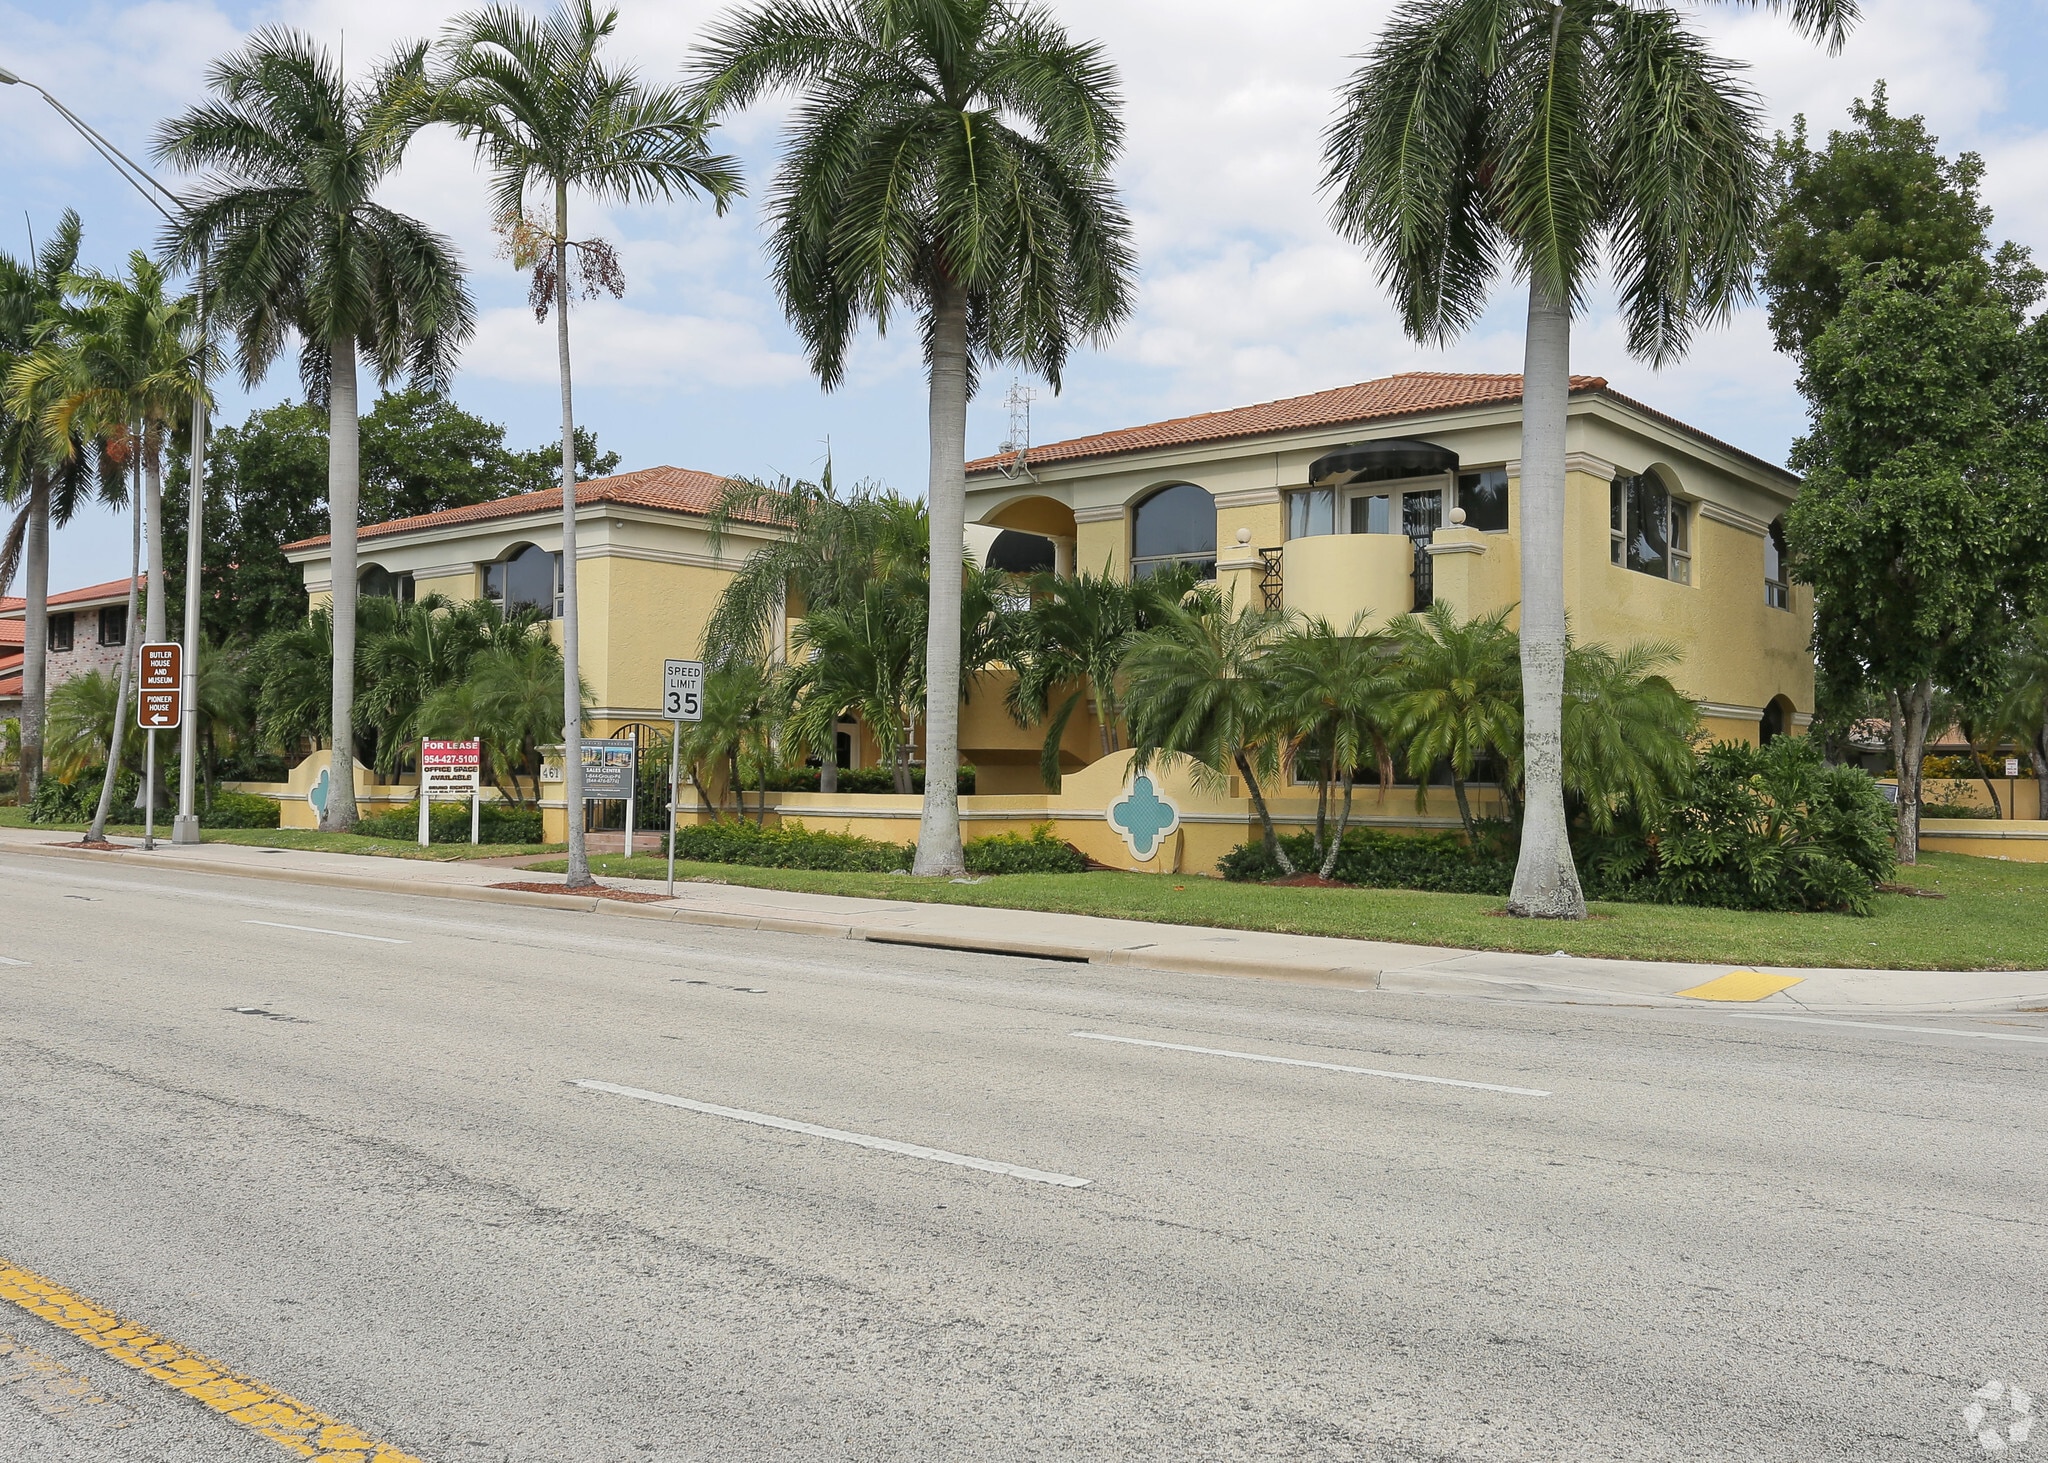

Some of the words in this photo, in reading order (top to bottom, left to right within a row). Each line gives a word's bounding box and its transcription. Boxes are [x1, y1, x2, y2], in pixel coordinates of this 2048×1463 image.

[149, 651, 172, 659] BUTLER
[154, 668, 167, 676] AND
[667, 666, 701, 678] SPEED
[670, 679, 696, 689] LIMIT
[667, 691, 698, 715] 35
[424, 742, 444, 750] FOR
[446, 742, 478, 750] LEASE
[424, 755, 478, 764] 954-427-5100
[543, 768, 559, 778] 461
